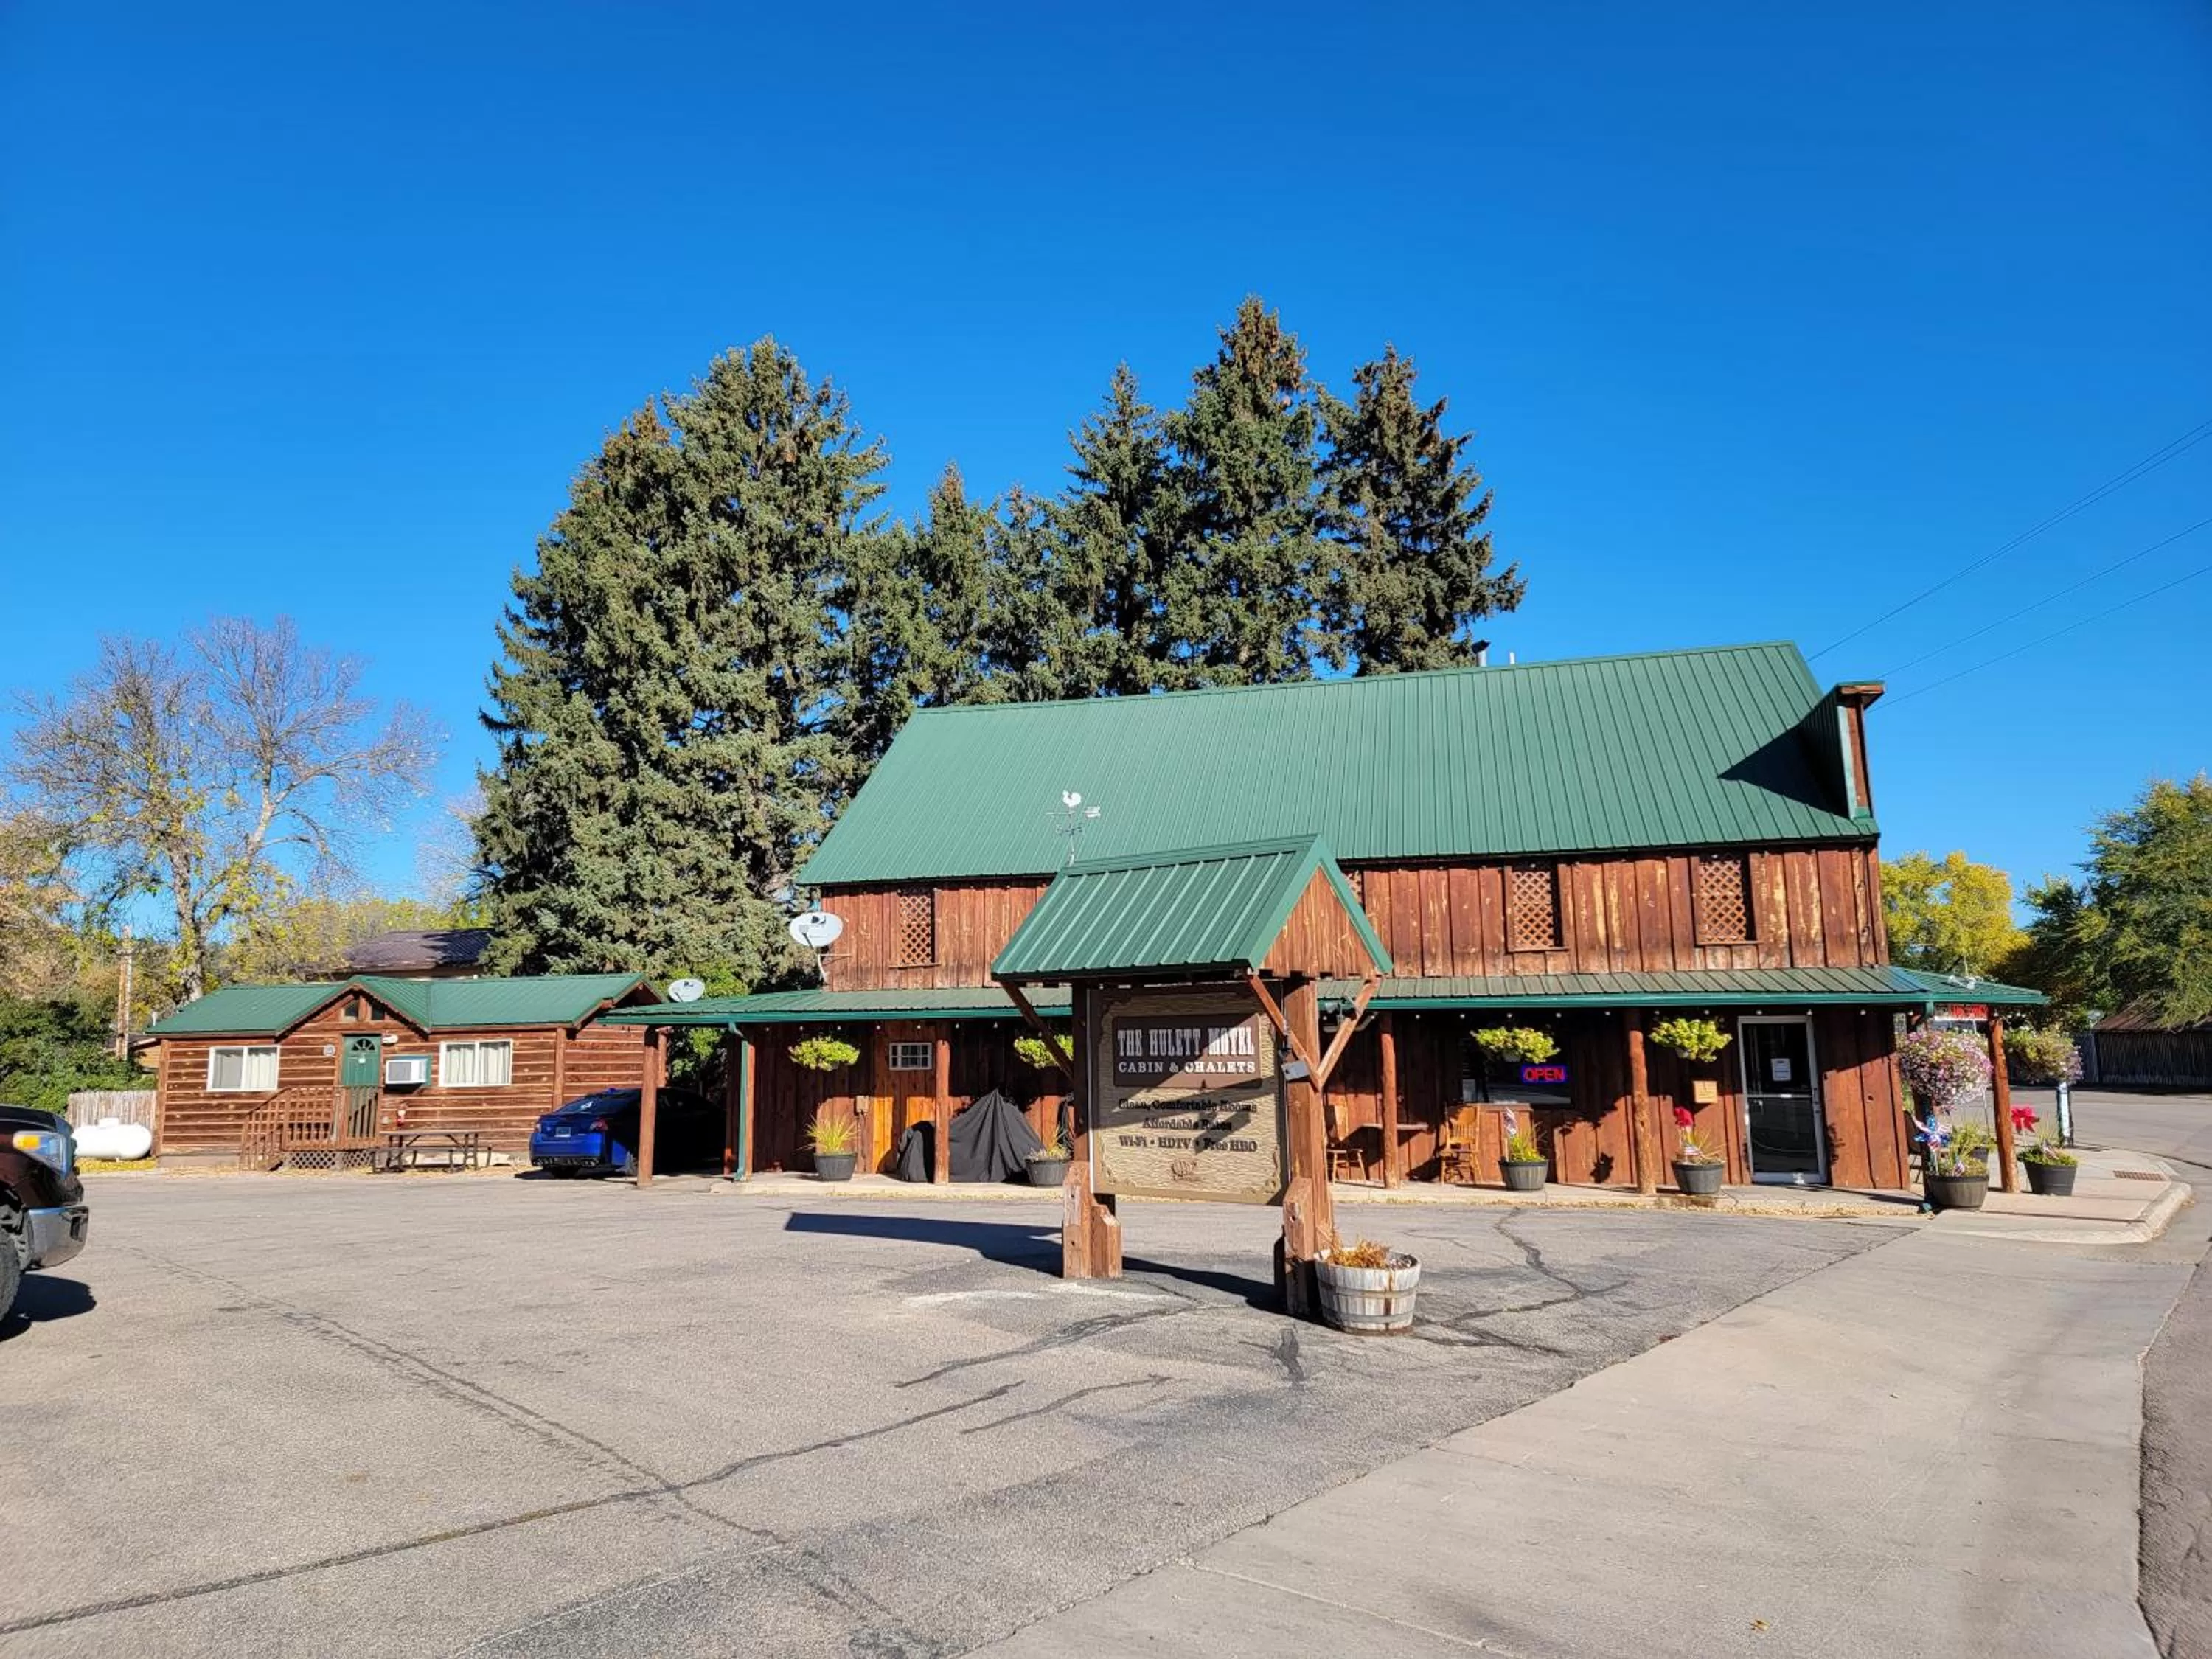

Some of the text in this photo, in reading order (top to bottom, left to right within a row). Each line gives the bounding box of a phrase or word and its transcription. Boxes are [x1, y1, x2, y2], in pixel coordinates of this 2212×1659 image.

[1117, 1026, 1255, 1057] THE HULETT MOTEL
[1119, 1061, 1256, 1074] CABIN & CHALETS
[1523, 1067, 1565, 1082] OPEN
[1142, 1117, 1199, 1130] Affordable
[1157, 1136, 1192, 1149] HDTV
[1230, 1139, 1258, 1152] HBO
